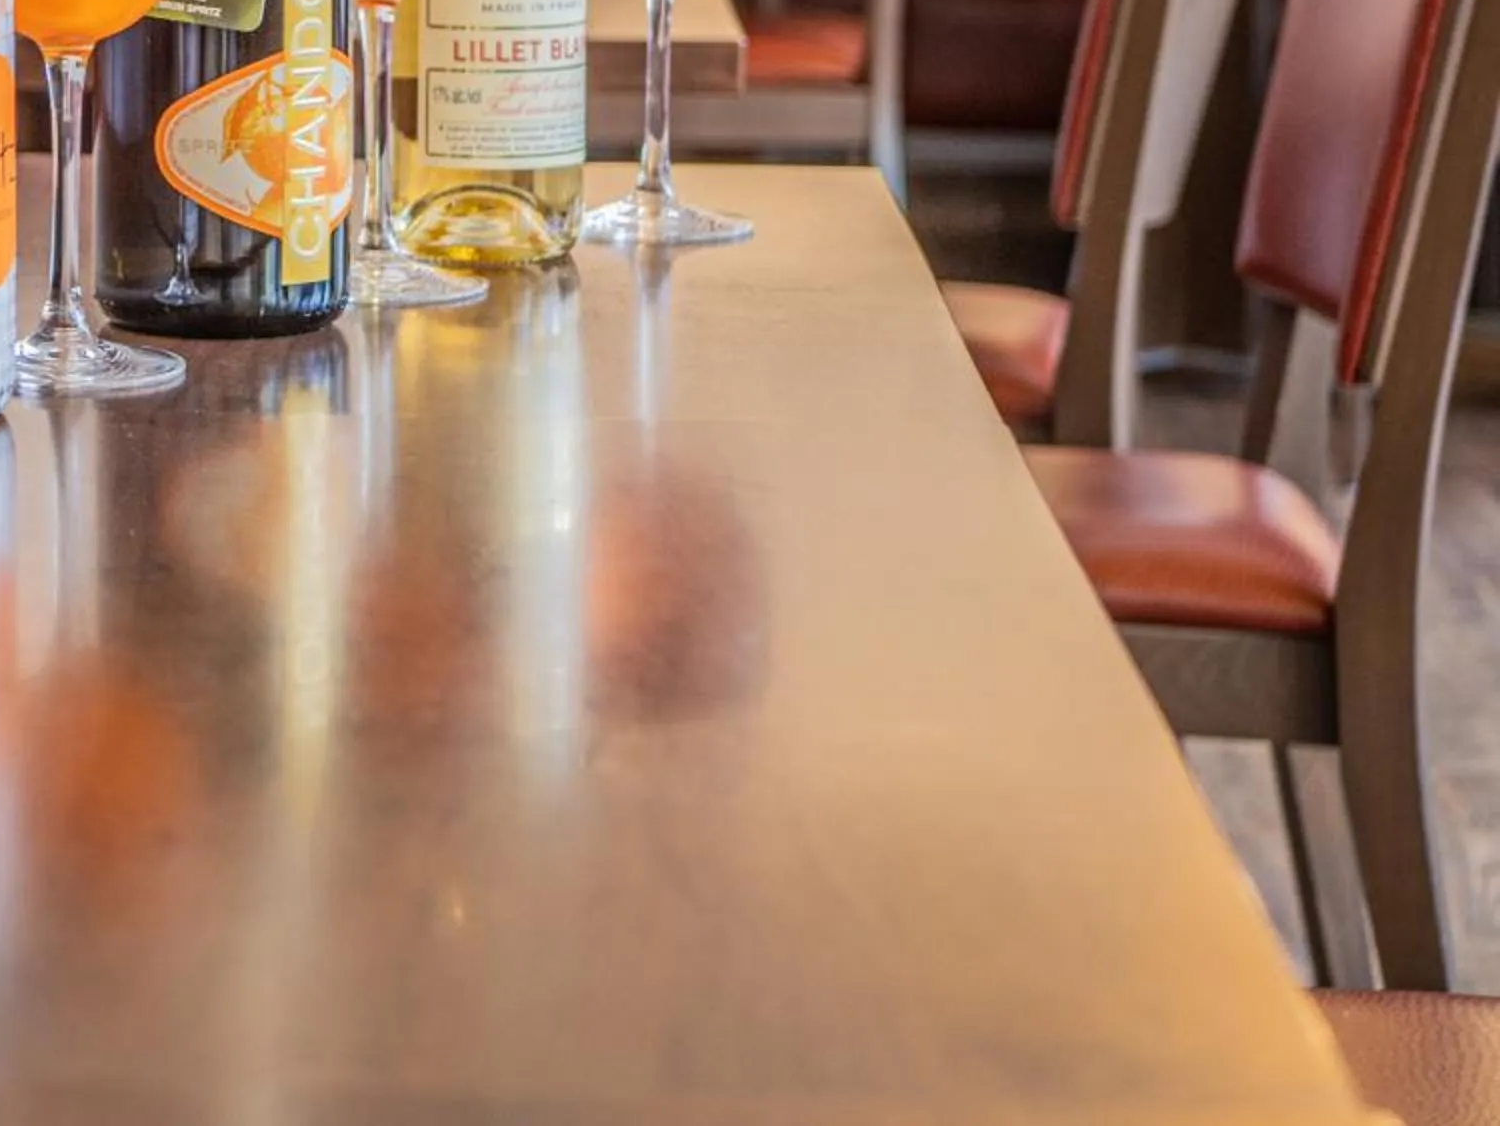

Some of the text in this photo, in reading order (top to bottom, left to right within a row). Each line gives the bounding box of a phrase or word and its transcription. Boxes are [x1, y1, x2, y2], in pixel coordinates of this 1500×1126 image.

[481, 2, 523, 13] MADE
[531, 1, 545, 12] IN
[453, 34, 582, 63] LILLET BLA
